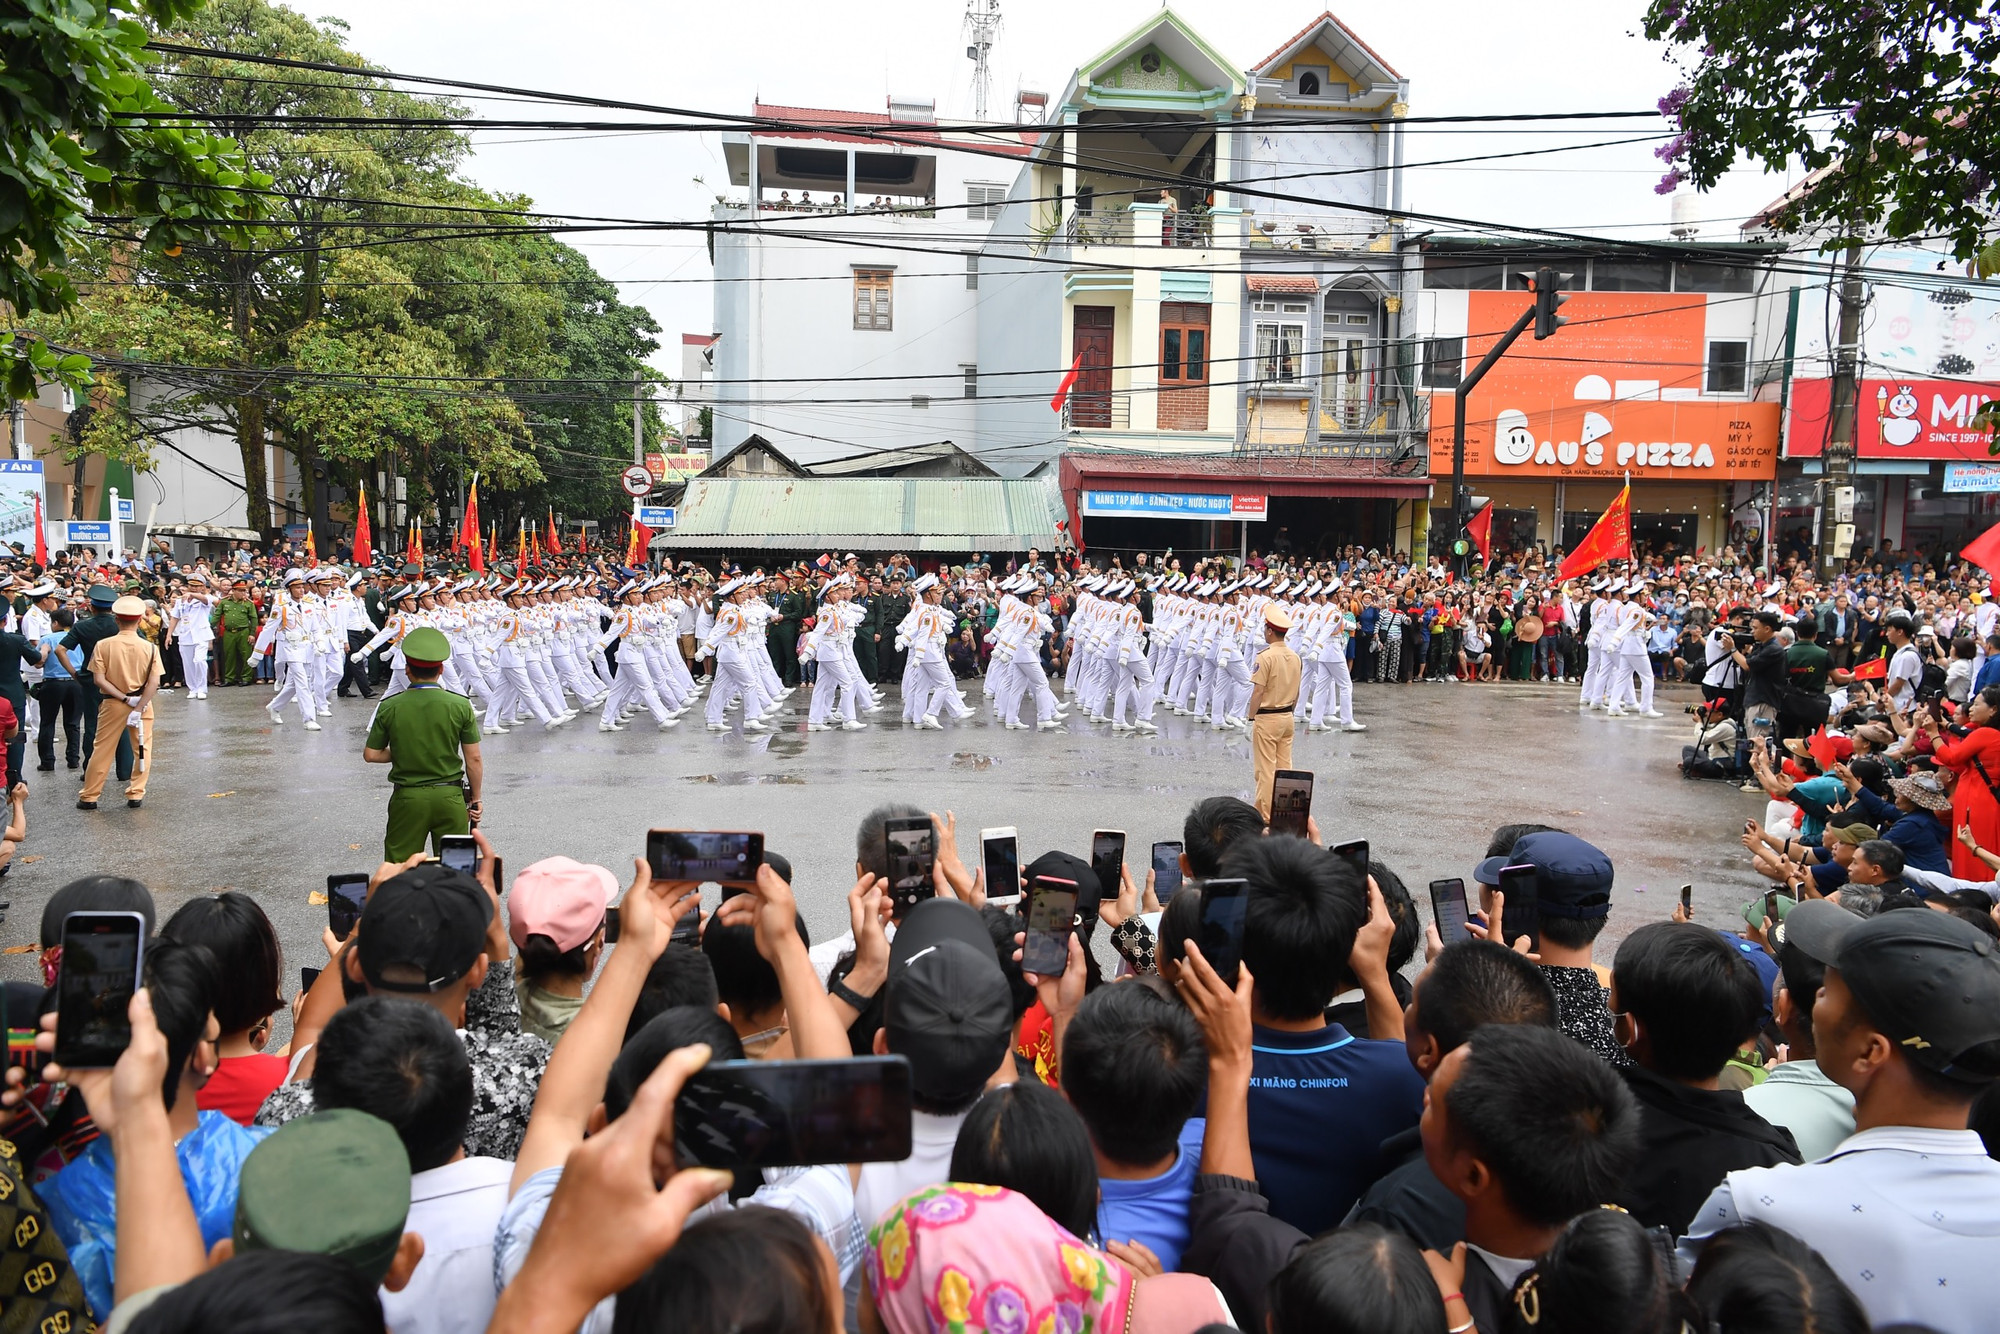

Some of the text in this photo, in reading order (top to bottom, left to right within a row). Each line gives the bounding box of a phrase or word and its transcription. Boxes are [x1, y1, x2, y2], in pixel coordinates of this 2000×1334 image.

[1729, 421, 1752, 430] PIZZA
[1929, 433, 1957, 443] SINCE
[1959, 433, 1980, 443] 1997
[1616, 442, 1715, 468] PIZZA
[1727, 445, 1739, 455] GÀ
[668, 456, 690, 469] NƯỚNG
[1095, 493, 1114, 505] HÀNG
[1115, 495, 1129, 507] TẠP
[1130, 493, 1144, 506] HÓA
[1149, 495, 1168, 507] BÁNH
[1188, 496, 1207, 508] NƯỚC
[1208, 498, 1226, 511] NGỌT
[1249, 1076, 1349, 1089] XI MĂNG CHINFON
